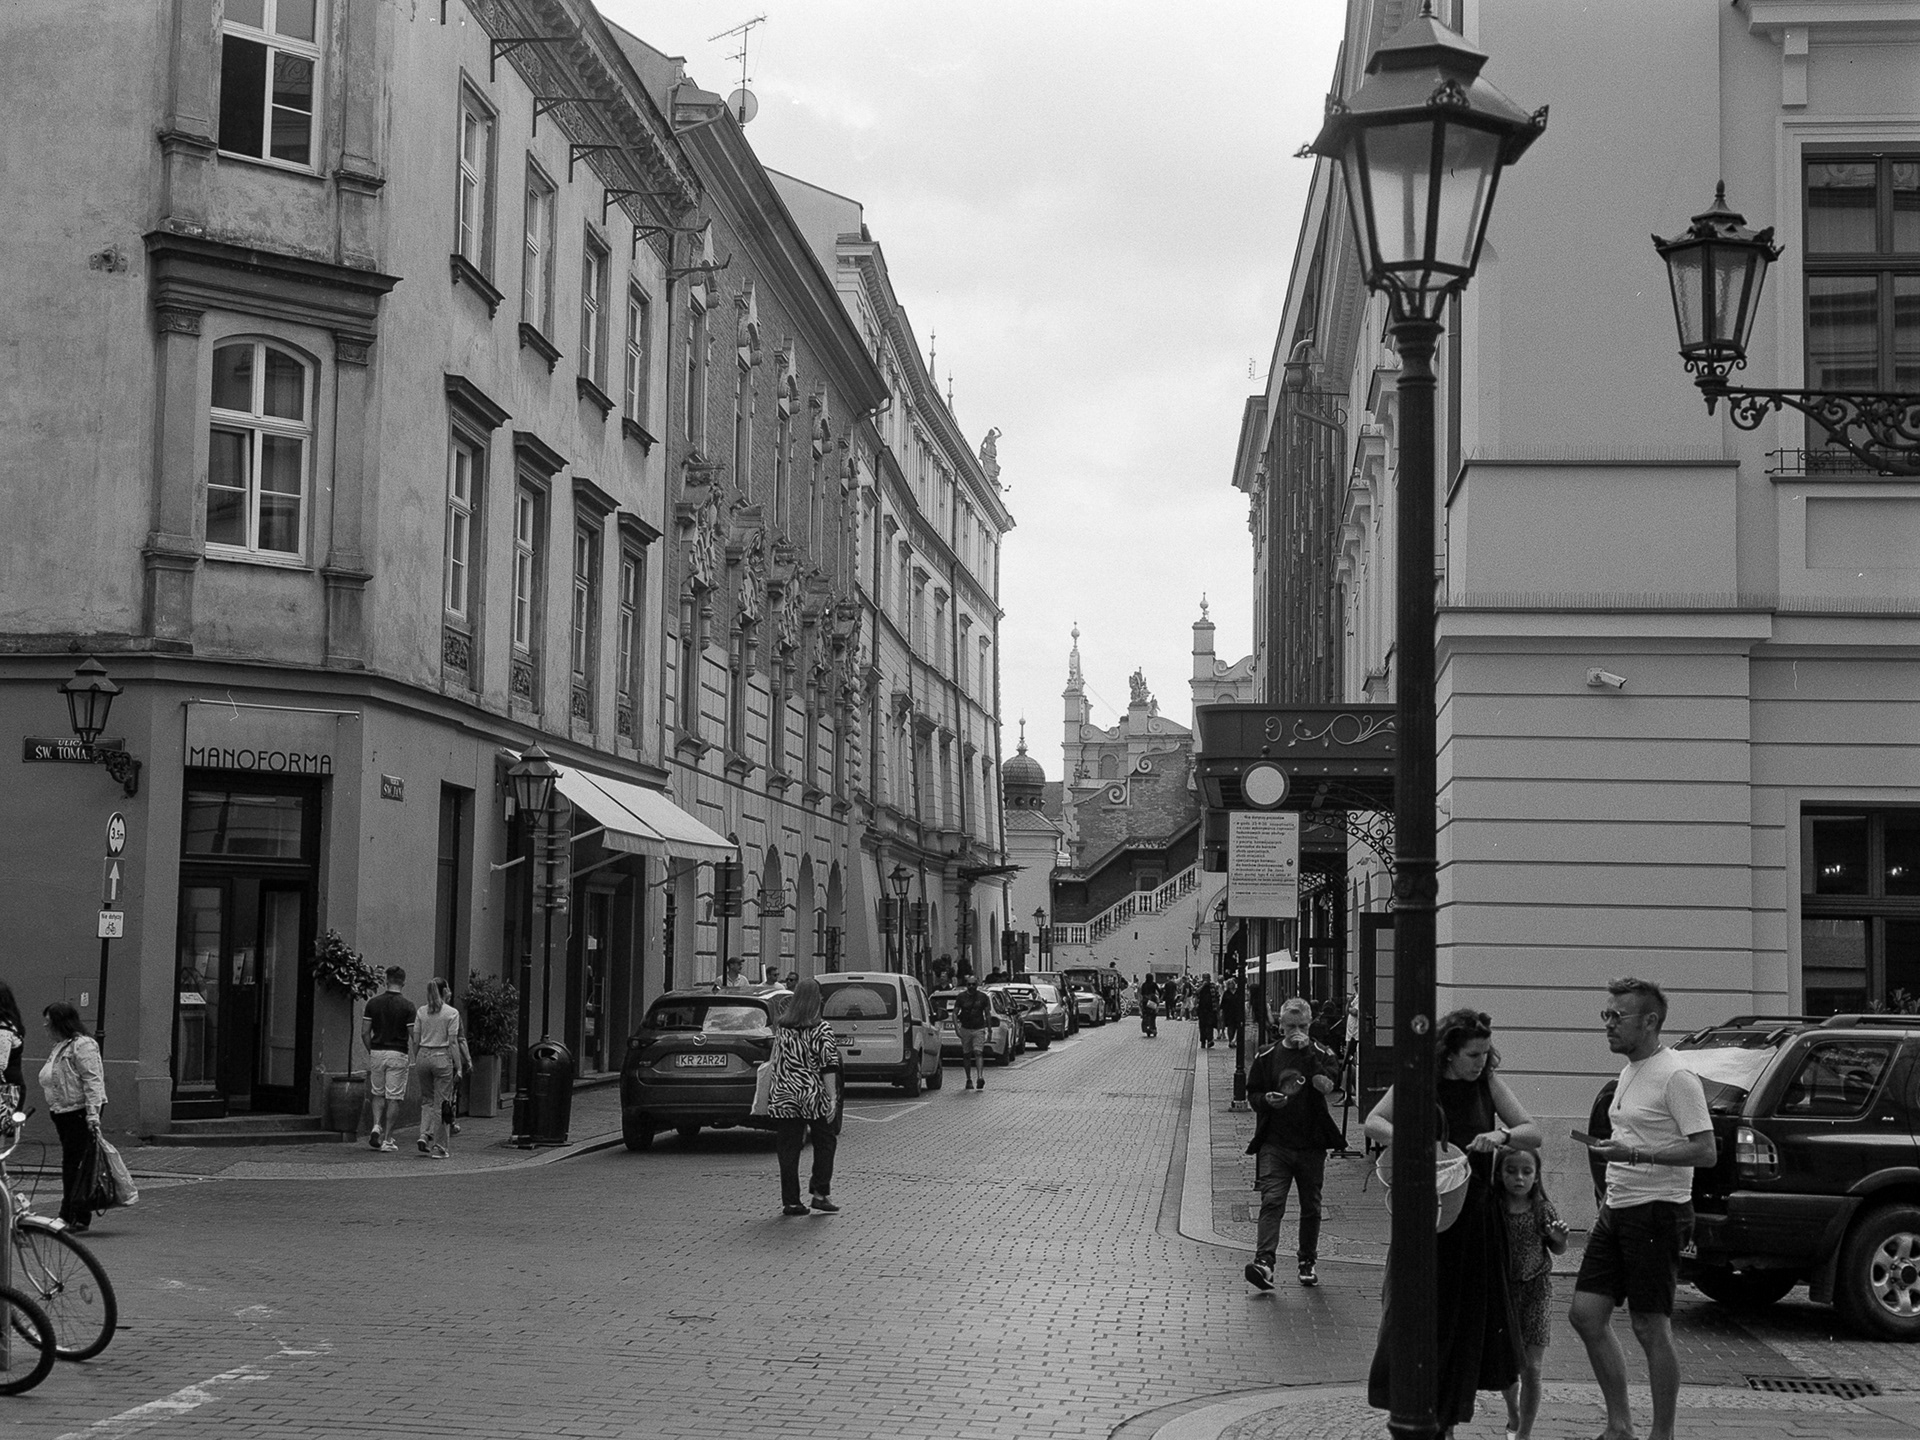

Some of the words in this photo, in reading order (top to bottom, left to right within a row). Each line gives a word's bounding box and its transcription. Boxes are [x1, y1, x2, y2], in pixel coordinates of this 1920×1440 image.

[35, 745, 53, 760] ŚW.
[57, 747, 90, 760] TOMA
[190, 746, 332, 775] MANOFORMA
[681, 1055, 695, 1065] KR
[696, 1055, 725, 1065] 2AR24
